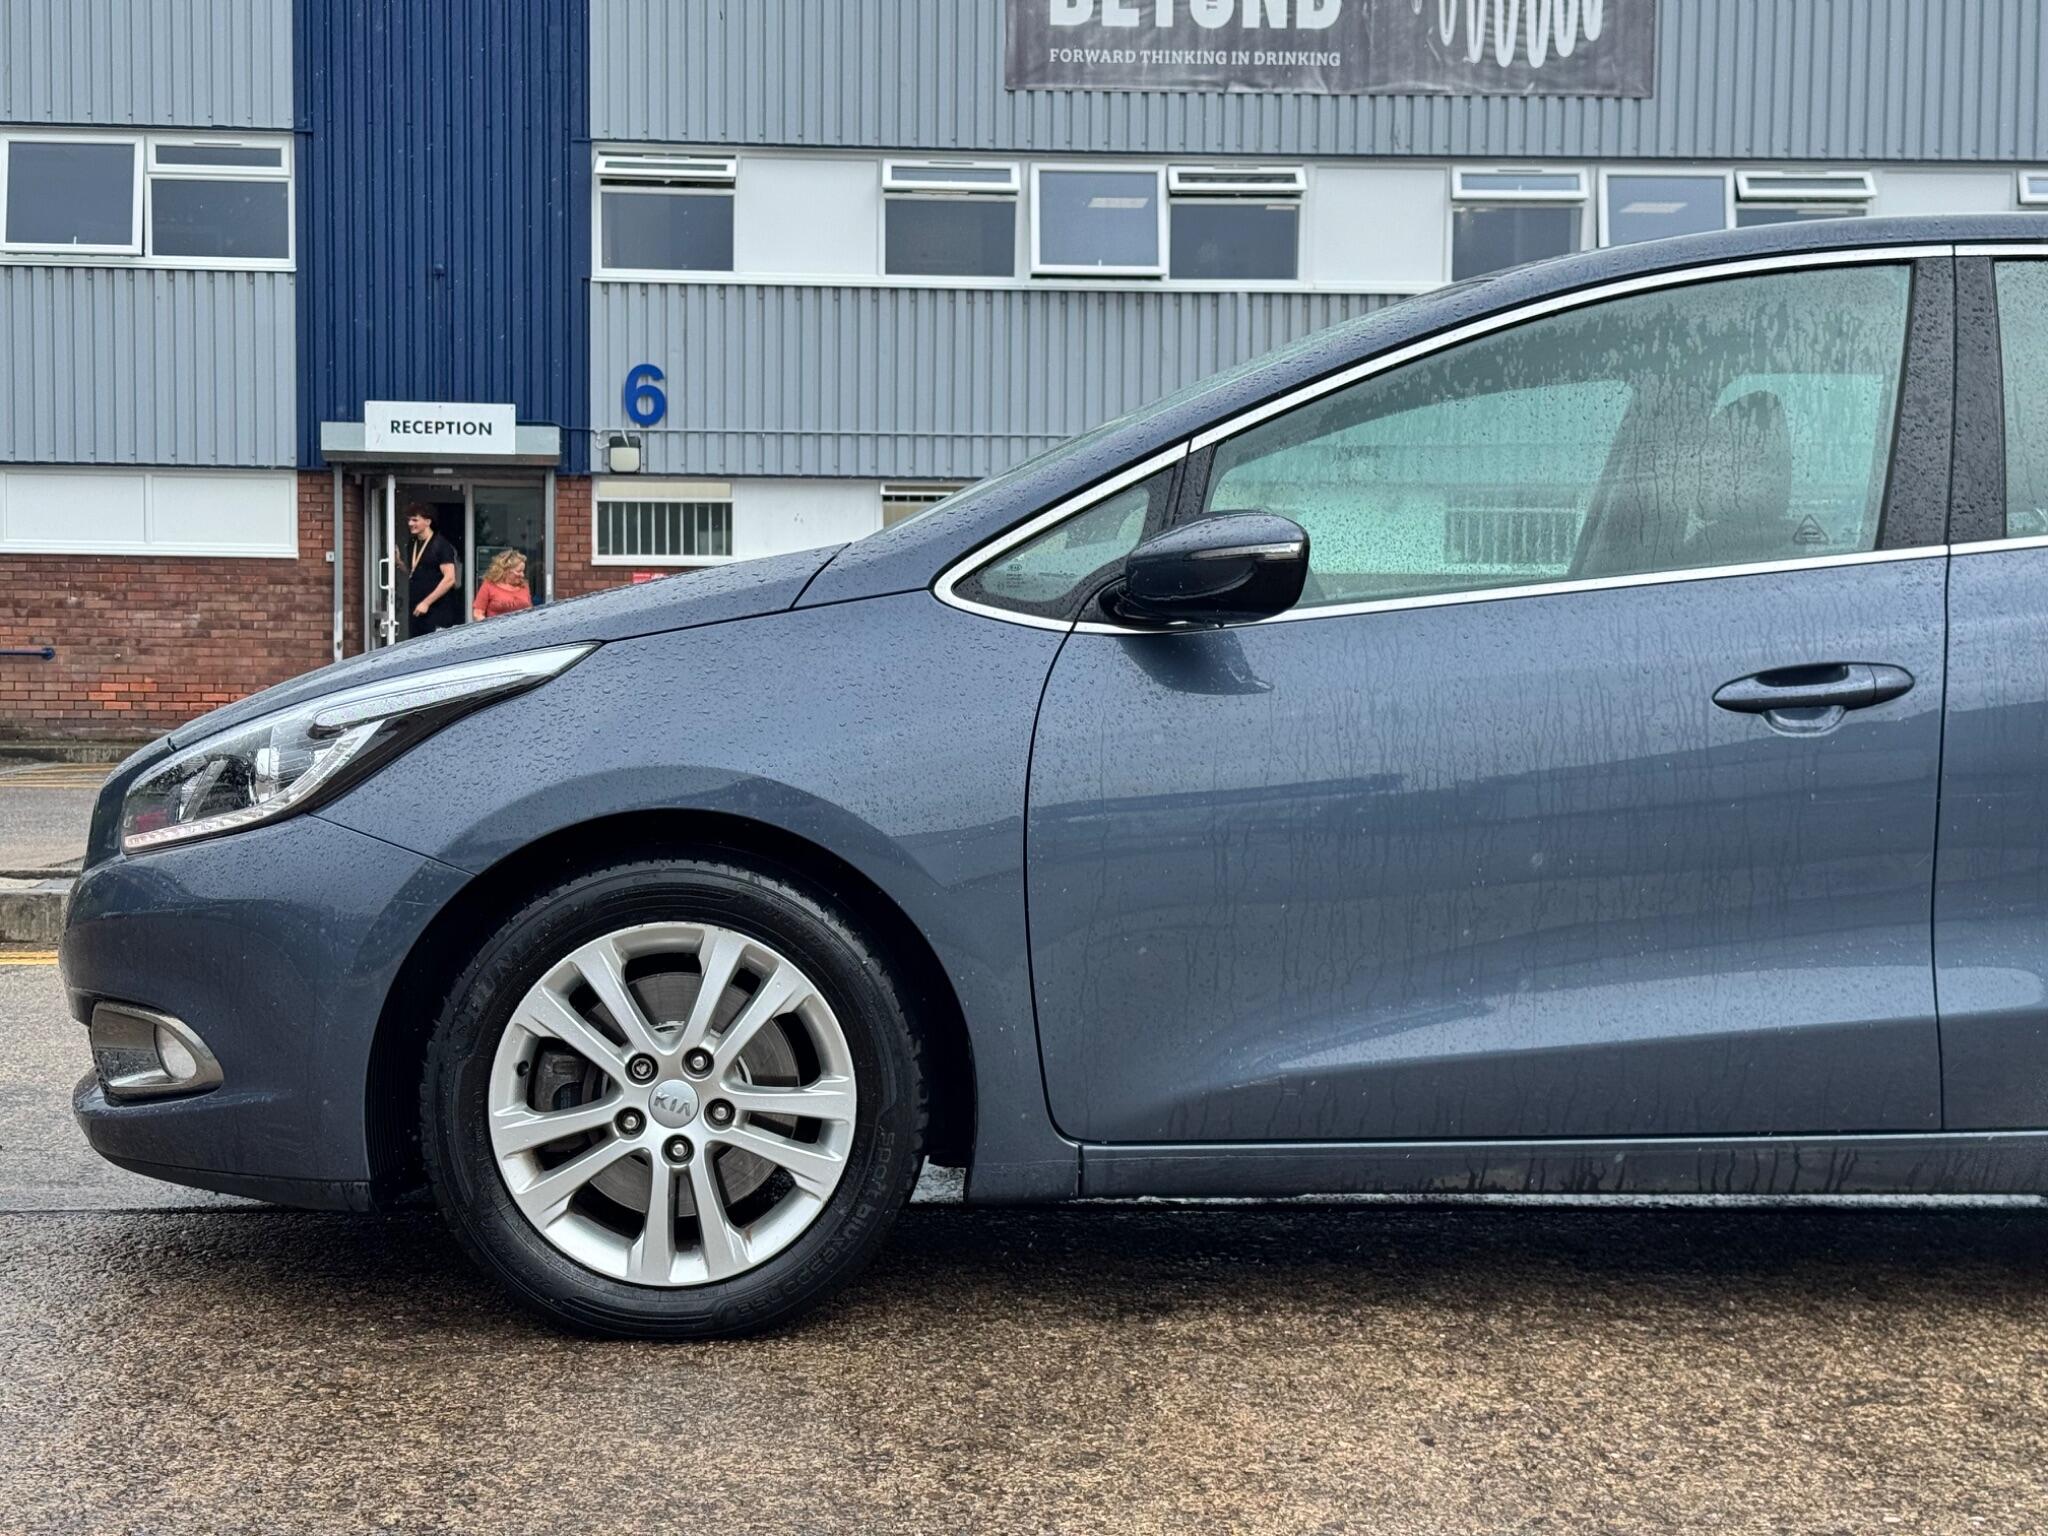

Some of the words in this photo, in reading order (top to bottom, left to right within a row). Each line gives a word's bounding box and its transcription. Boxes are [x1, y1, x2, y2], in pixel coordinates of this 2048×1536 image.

[1049, 48, 1136, 64] FORWARD
[1140, 50, 1227, 65] THINKING
[1231, 51, 1250, 65] IN
[1254, 51, 1341, 67] DRINKING
[624, 363, 666, 426] 6
[390, 419, 492, 436] RECEPTION
[653, 1095, 691, 1117] KIA
